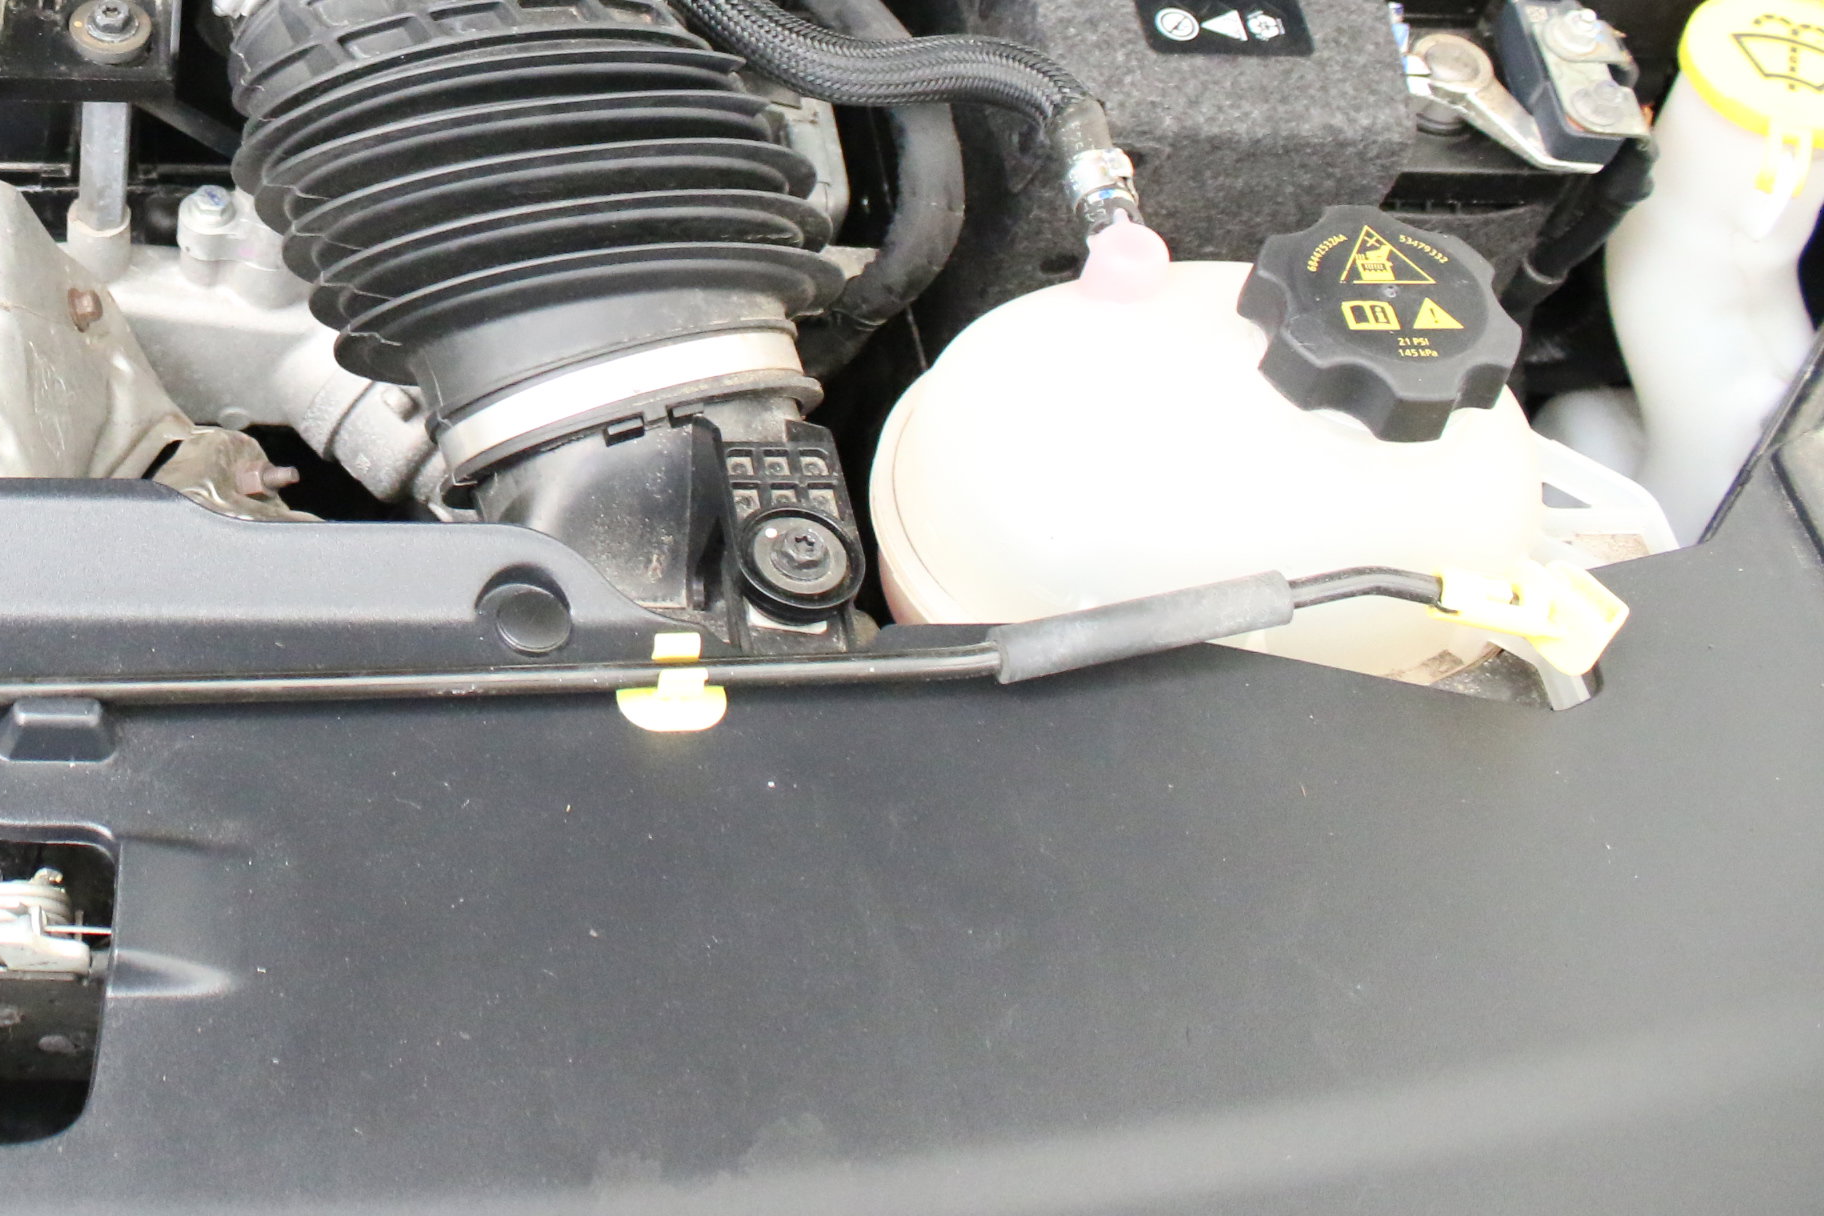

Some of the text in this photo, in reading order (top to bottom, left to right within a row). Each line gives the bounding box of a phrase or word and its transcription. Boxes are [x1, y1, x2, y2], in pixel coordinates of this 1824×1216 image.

[1397, 337, 1430, 346] 21 PSI
[1398, 348, 1439, 358] 145 kPa
